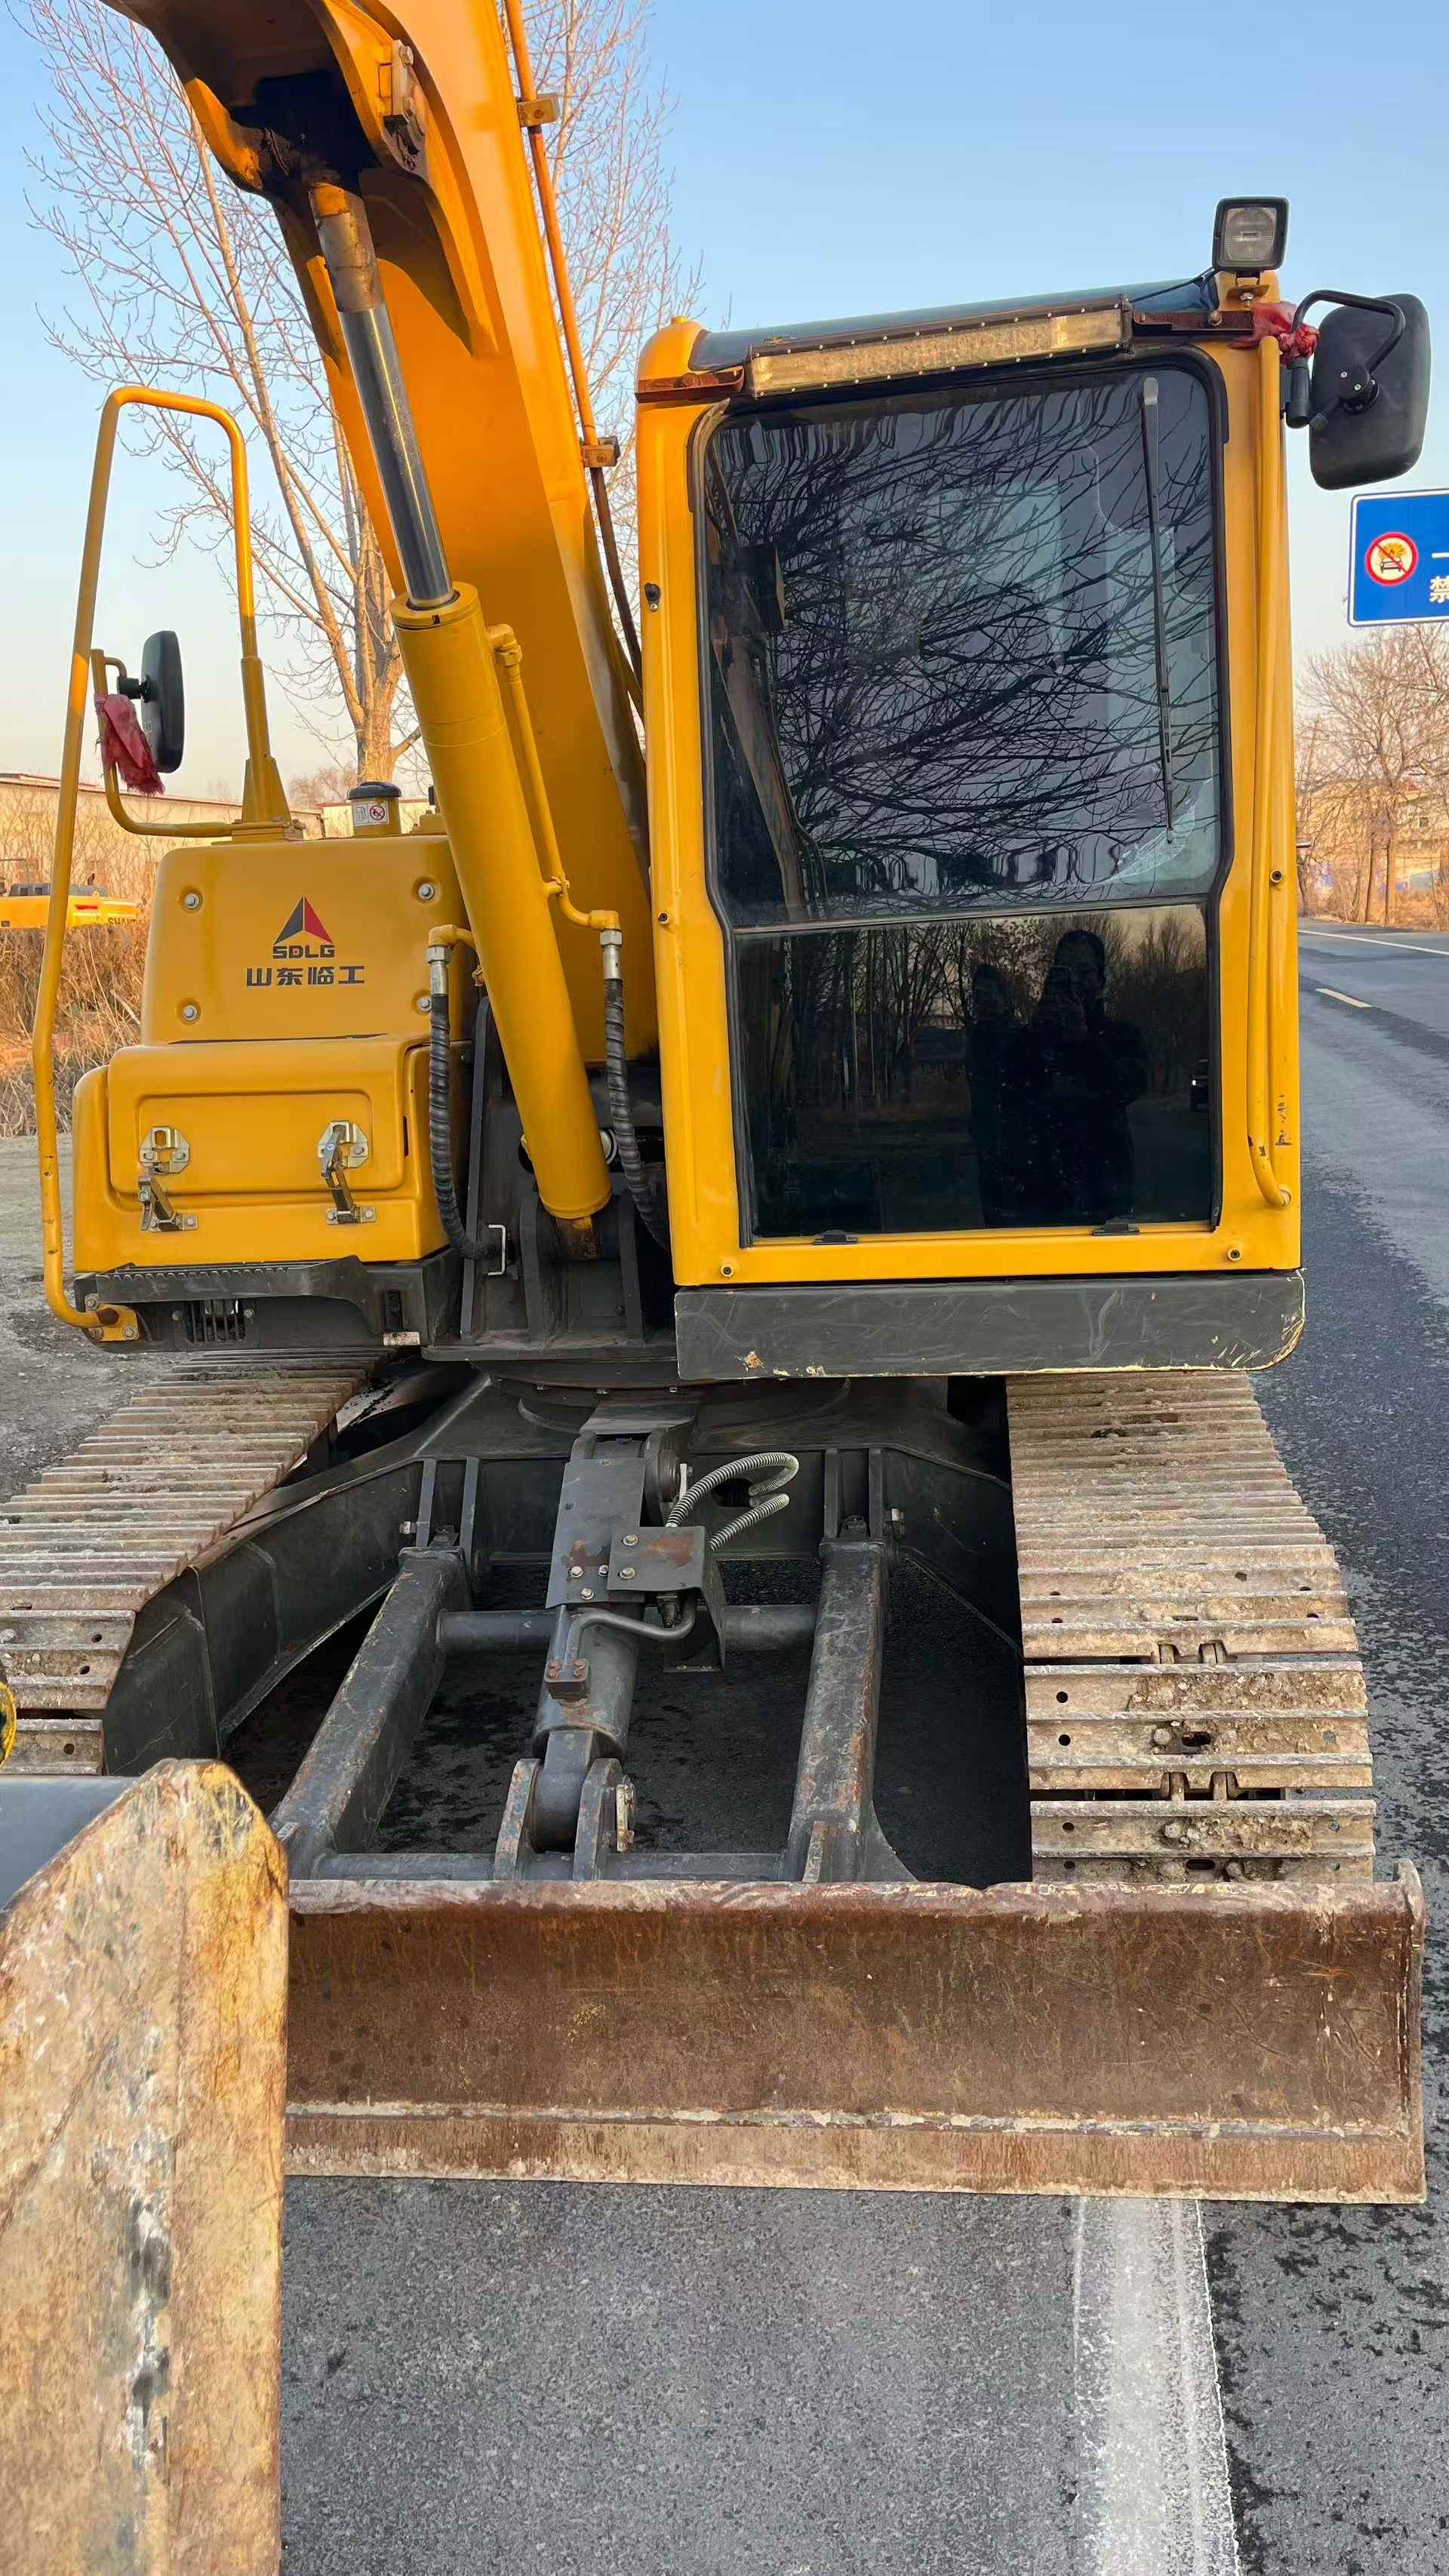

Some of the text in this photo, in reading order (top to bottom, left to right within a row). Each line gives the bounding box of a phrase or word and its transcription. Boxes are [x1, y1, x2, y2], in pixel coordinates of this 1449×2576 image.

[272, 945, 335, 959] SDLG
[246, 966, 365, 987] 山东临工
